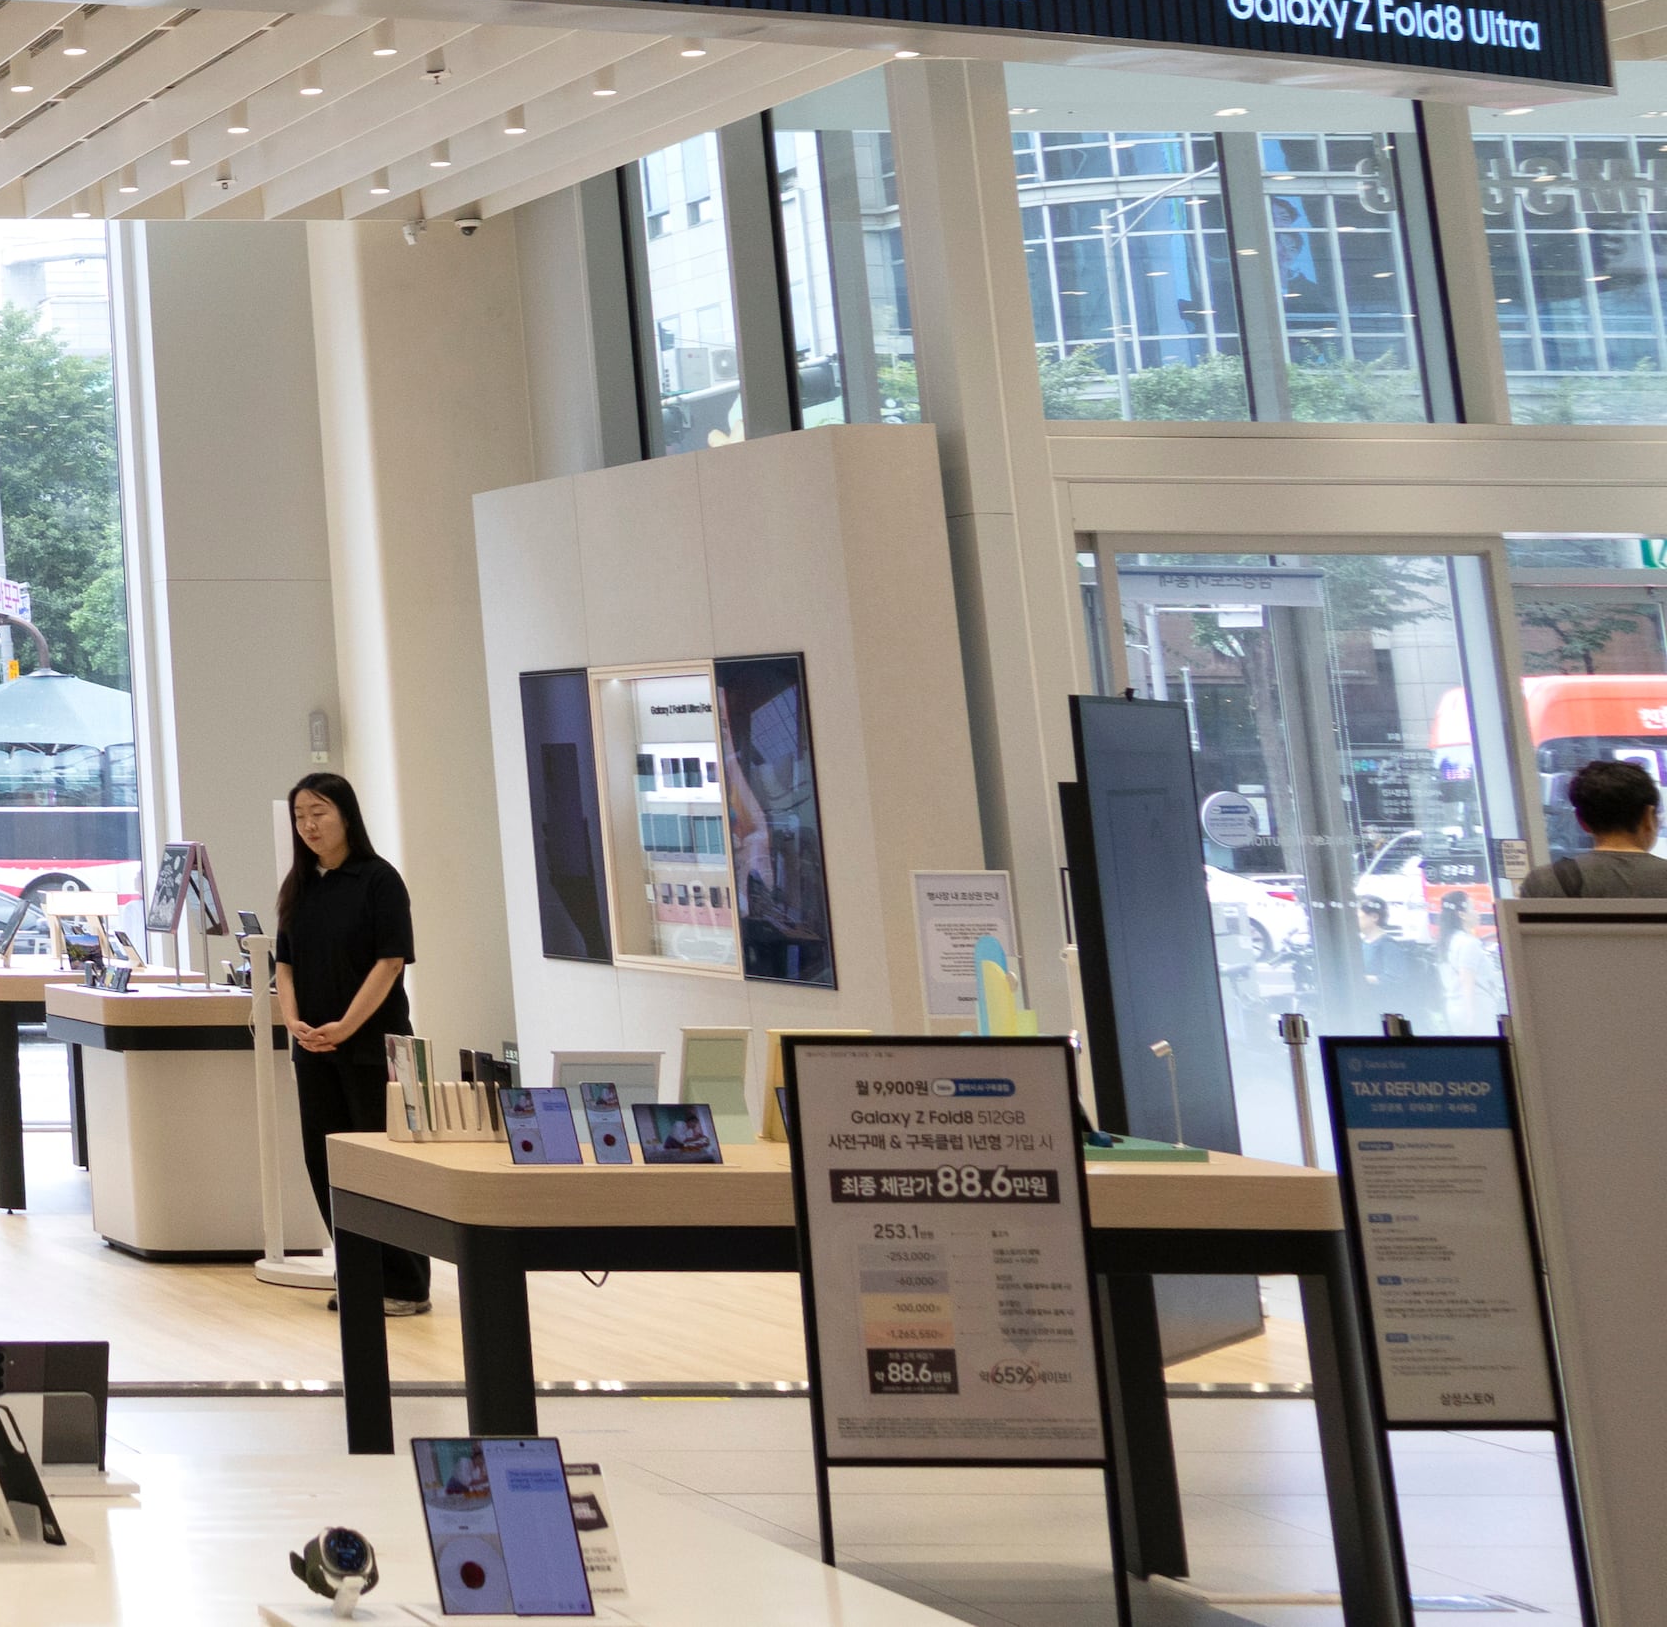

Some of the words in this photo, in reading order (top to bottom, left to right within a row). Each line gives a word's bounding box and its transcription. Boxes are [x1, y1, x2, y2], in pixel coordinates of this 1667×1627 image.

[1469, 9, 1539, 50] Ultra
[855, 1080, 870, 1096] 월
[873, 1080, 929, 1097] 9,900원
[1351, 1081, 1383, 1096] TAX
[1384, 1081, 1445, 1096] REFUND
[1447, 1081, 1491, 1096] SHOP
[851, 1110, 909, 1128] Galaxy
[916, 1110, 925, 1124] Z
[929, 1110, 973, 1125] Fold8
[978, 1110, 1026, 1125] 512GB
[828, 1134, 886, 1151] 사전구매
[890, 1134, 902, 1149] &
[906, 1134, 963, 1151] 구독클럽
[967, 1134, 1001, 1151] 1년형
[1006, 1134, 1035, 1151] 가입
[1039, 1134, 1054, 1151] 시
[841, 1176, 877, 1196] 최종
[880, 1176, 934, 1197] 체감가
[936, 1165, 1049, 1199] 88.6만원
[992, 1366, 1035, 1384] 65%
[1440, 1392, 1495, 1406] 삼성스토어
